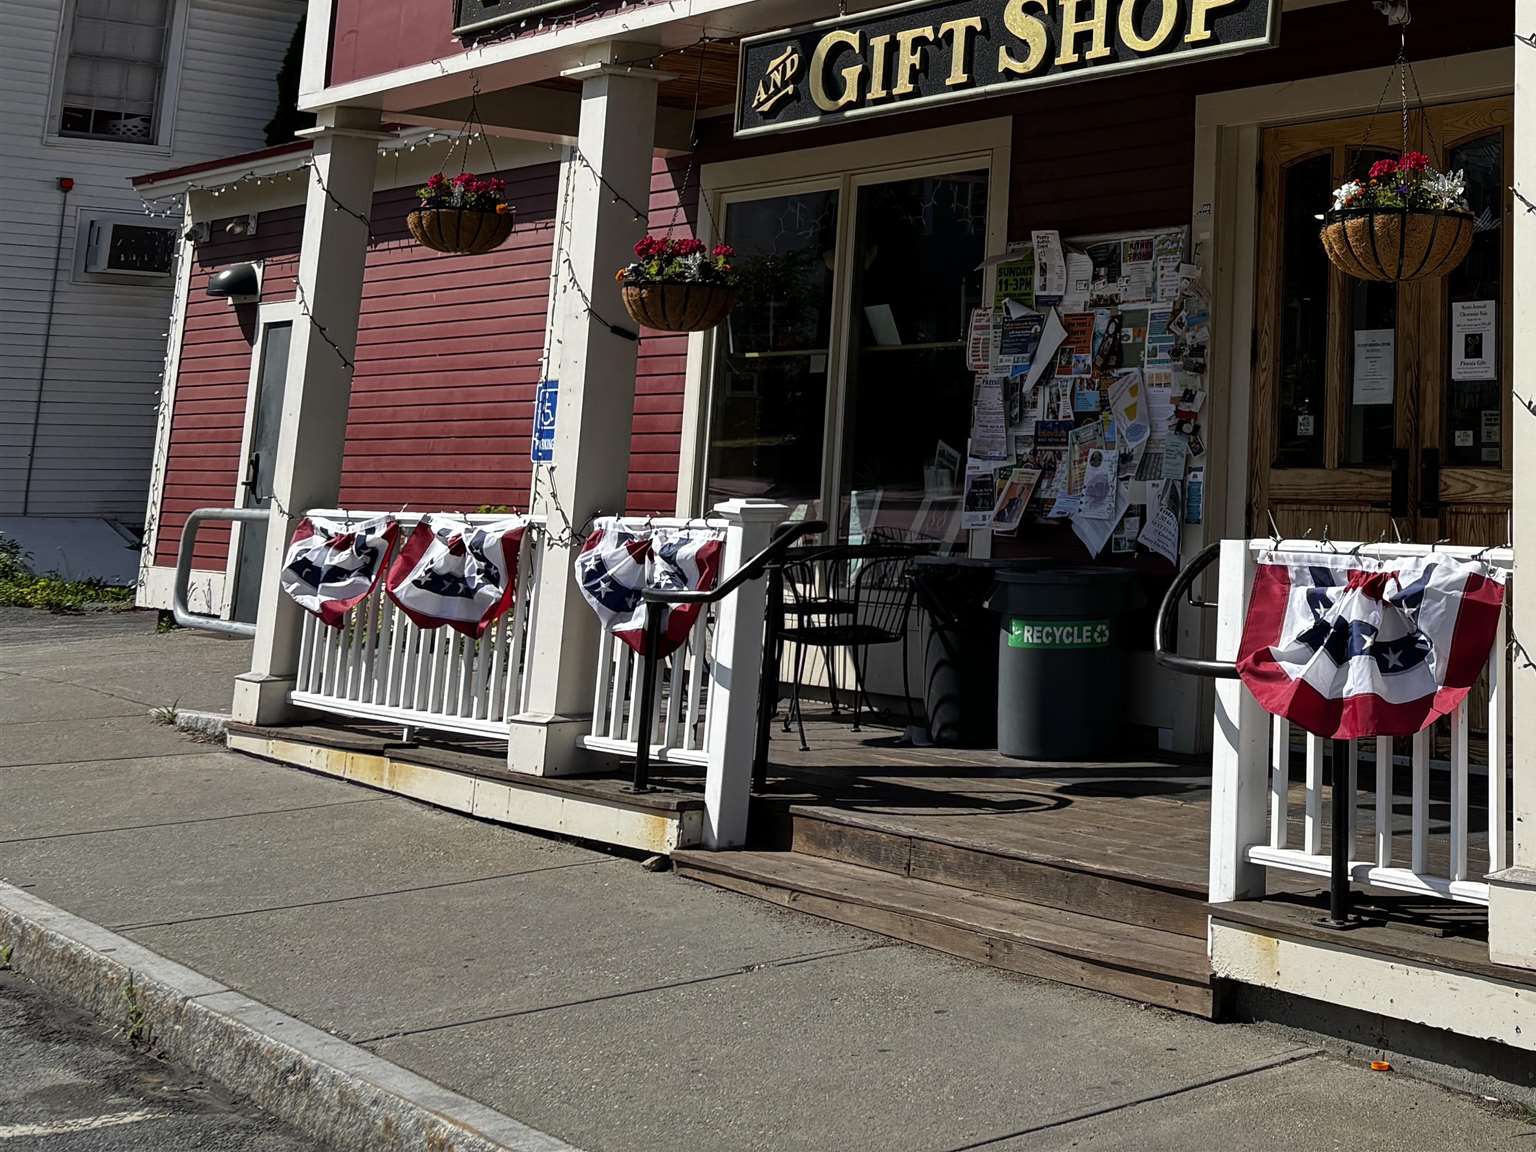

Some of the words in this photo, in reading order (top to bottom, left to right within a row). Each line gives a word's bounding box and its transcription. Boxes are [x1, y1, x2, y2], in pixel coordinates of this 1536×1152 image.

[751, 53, 799, 109] AND
[808, 16, 982, 113] GIFT
[1024, 624, 1092, 644] RECYCLE
